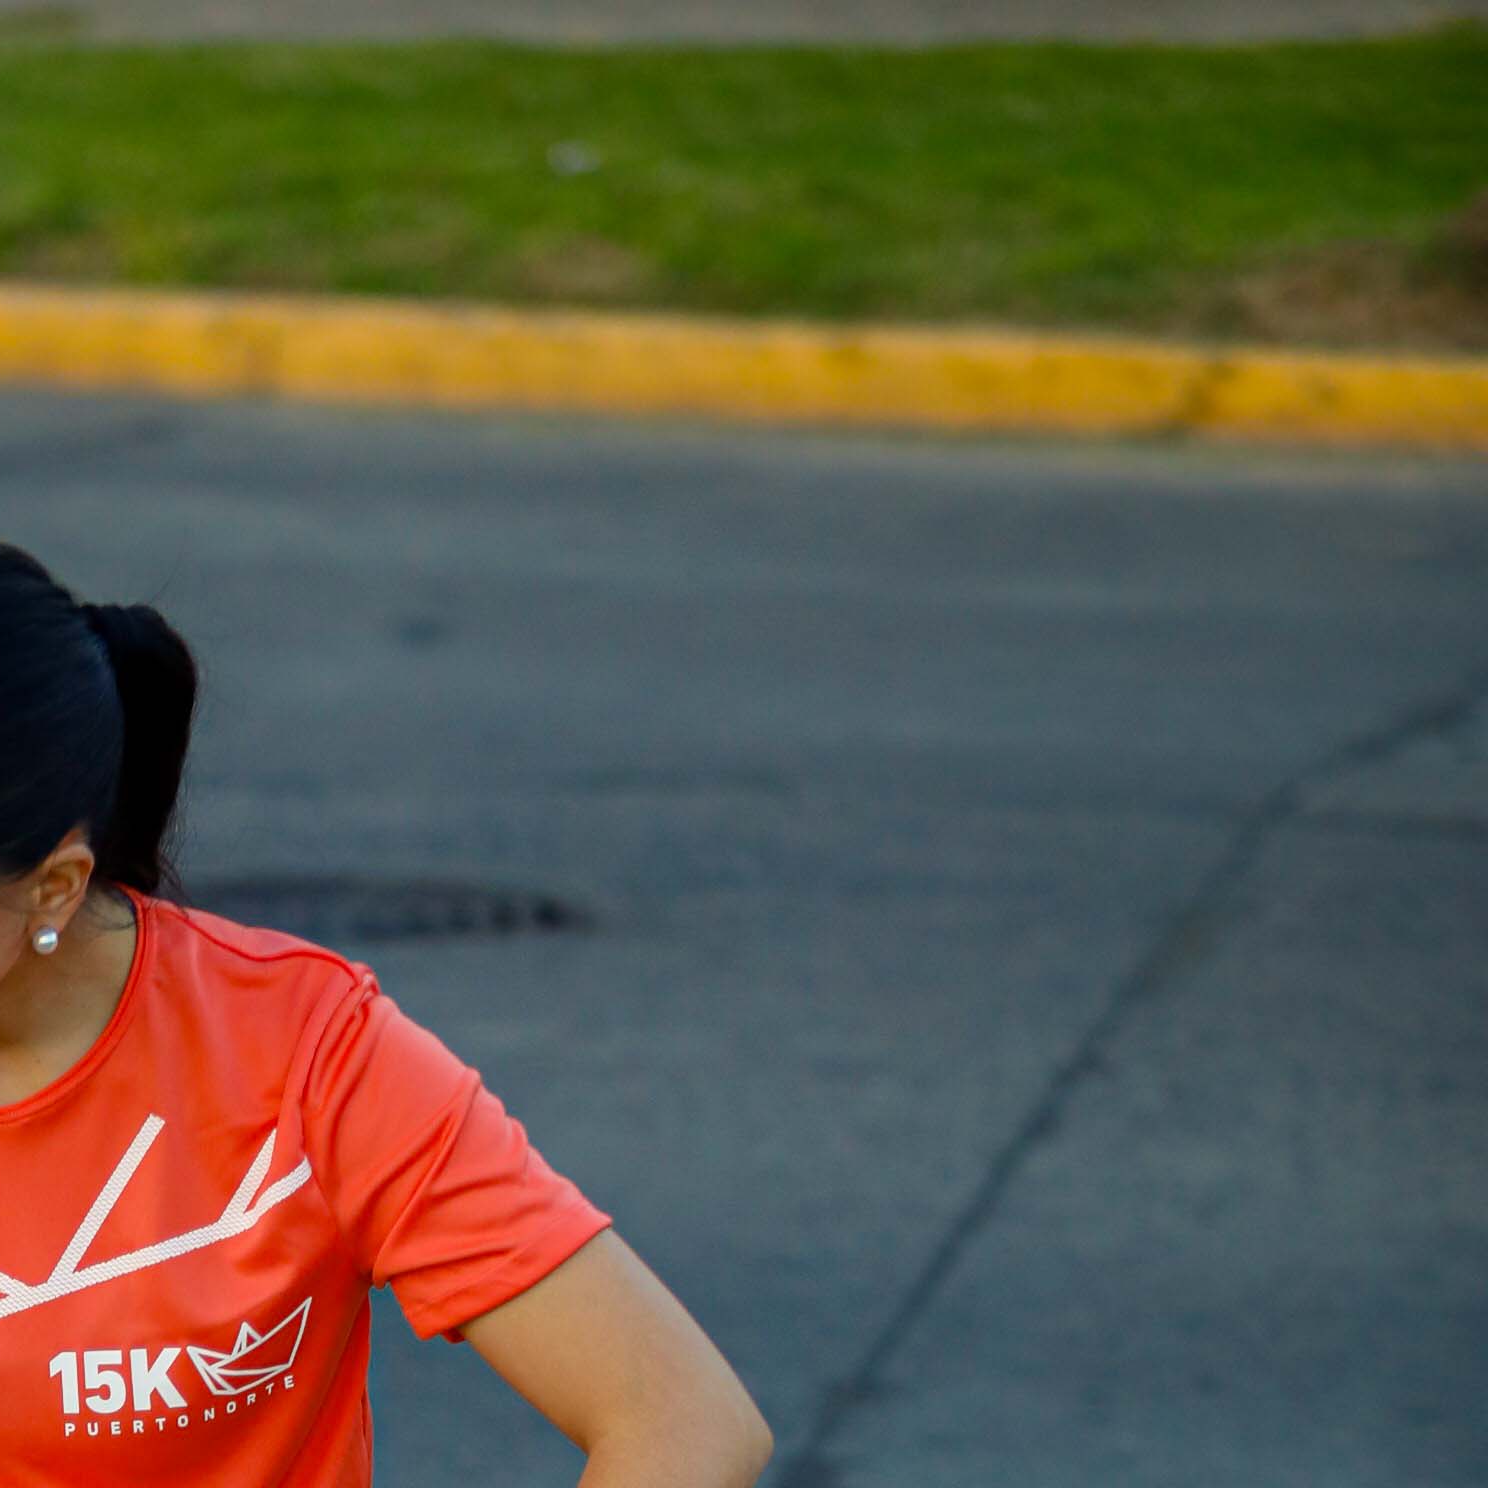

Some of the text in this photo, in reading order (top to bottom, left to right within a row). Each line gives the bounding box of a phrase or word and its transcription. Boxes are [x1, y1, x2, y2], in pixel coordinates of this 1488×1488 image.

[49, 1347, 188, 1415] 15K
[64, 1374, 295, 1437] PUERTO NORTE
